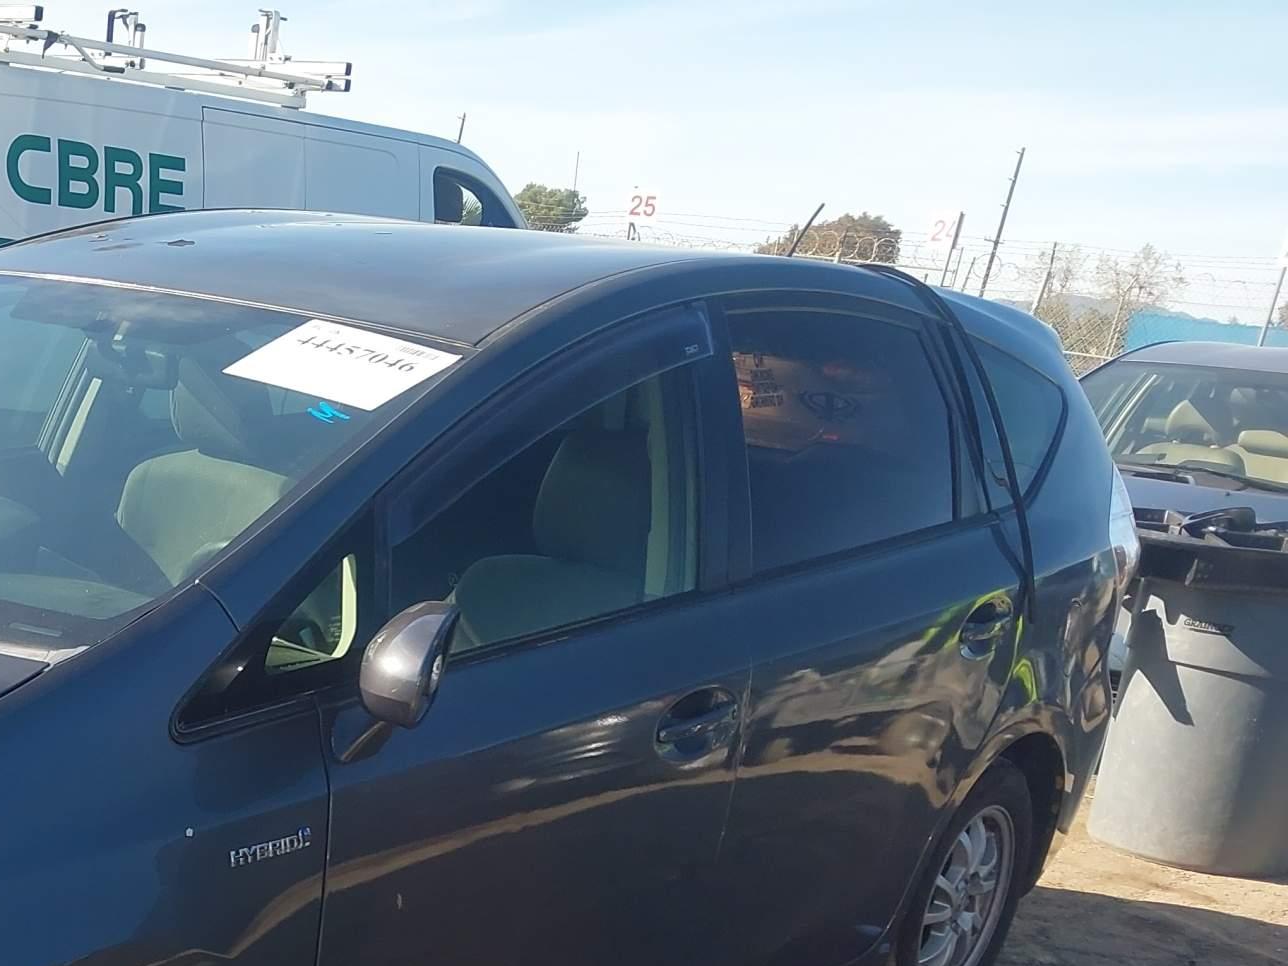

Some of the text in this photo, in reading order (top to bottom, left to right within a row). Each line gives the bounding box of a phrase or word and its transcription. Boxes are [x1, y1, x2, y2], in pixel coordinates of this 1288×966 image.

[6, 134, 186, 215] CBRE
[629, 195, 657, 217] 25
[229, 835, 299, 868] HYBRID
